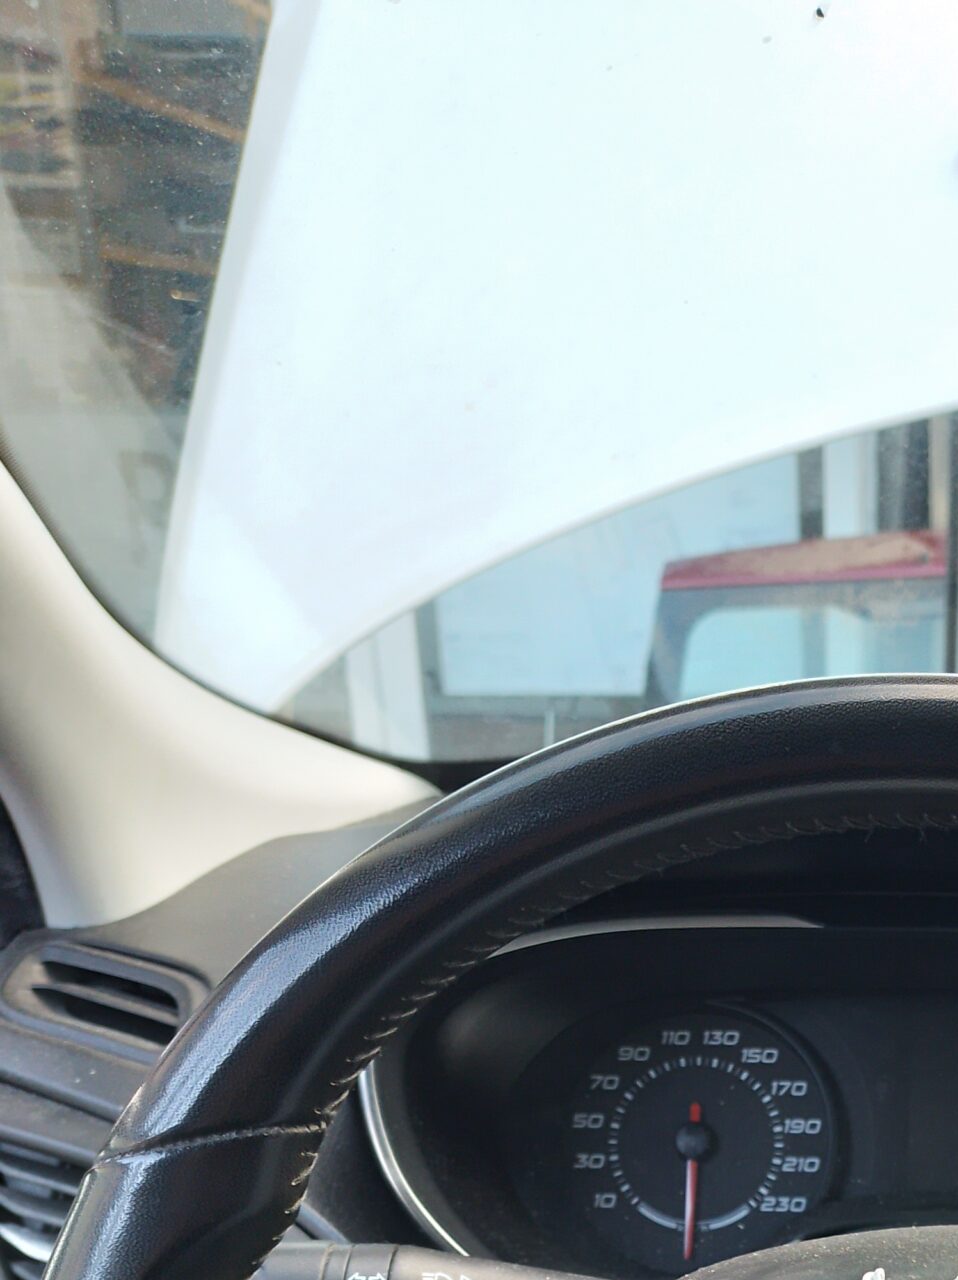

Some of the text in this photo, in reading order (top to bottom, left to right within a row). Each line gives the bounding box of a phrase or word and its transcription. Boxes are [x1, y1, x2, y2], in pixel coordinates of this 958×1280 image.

[661, 1031, 691, 1045] 110
[703, 1031, 740, 1046] 130
[617, 1047, 650, 1061] 90
[741, 1049, 778, 1063] 150
[590, 1075, 620, 1090] 70
[771, 1081, 808, 1096] 170
[572, 1113, 604, 1128] 50
[784, 1119, 821, 1134] 190
[574, 1154, 605, 1169] 30
[781, 1157, 820, 1172] 210
[594, 1193, 617, 1208] 10
[759, 1196, 807, 1212] 230
